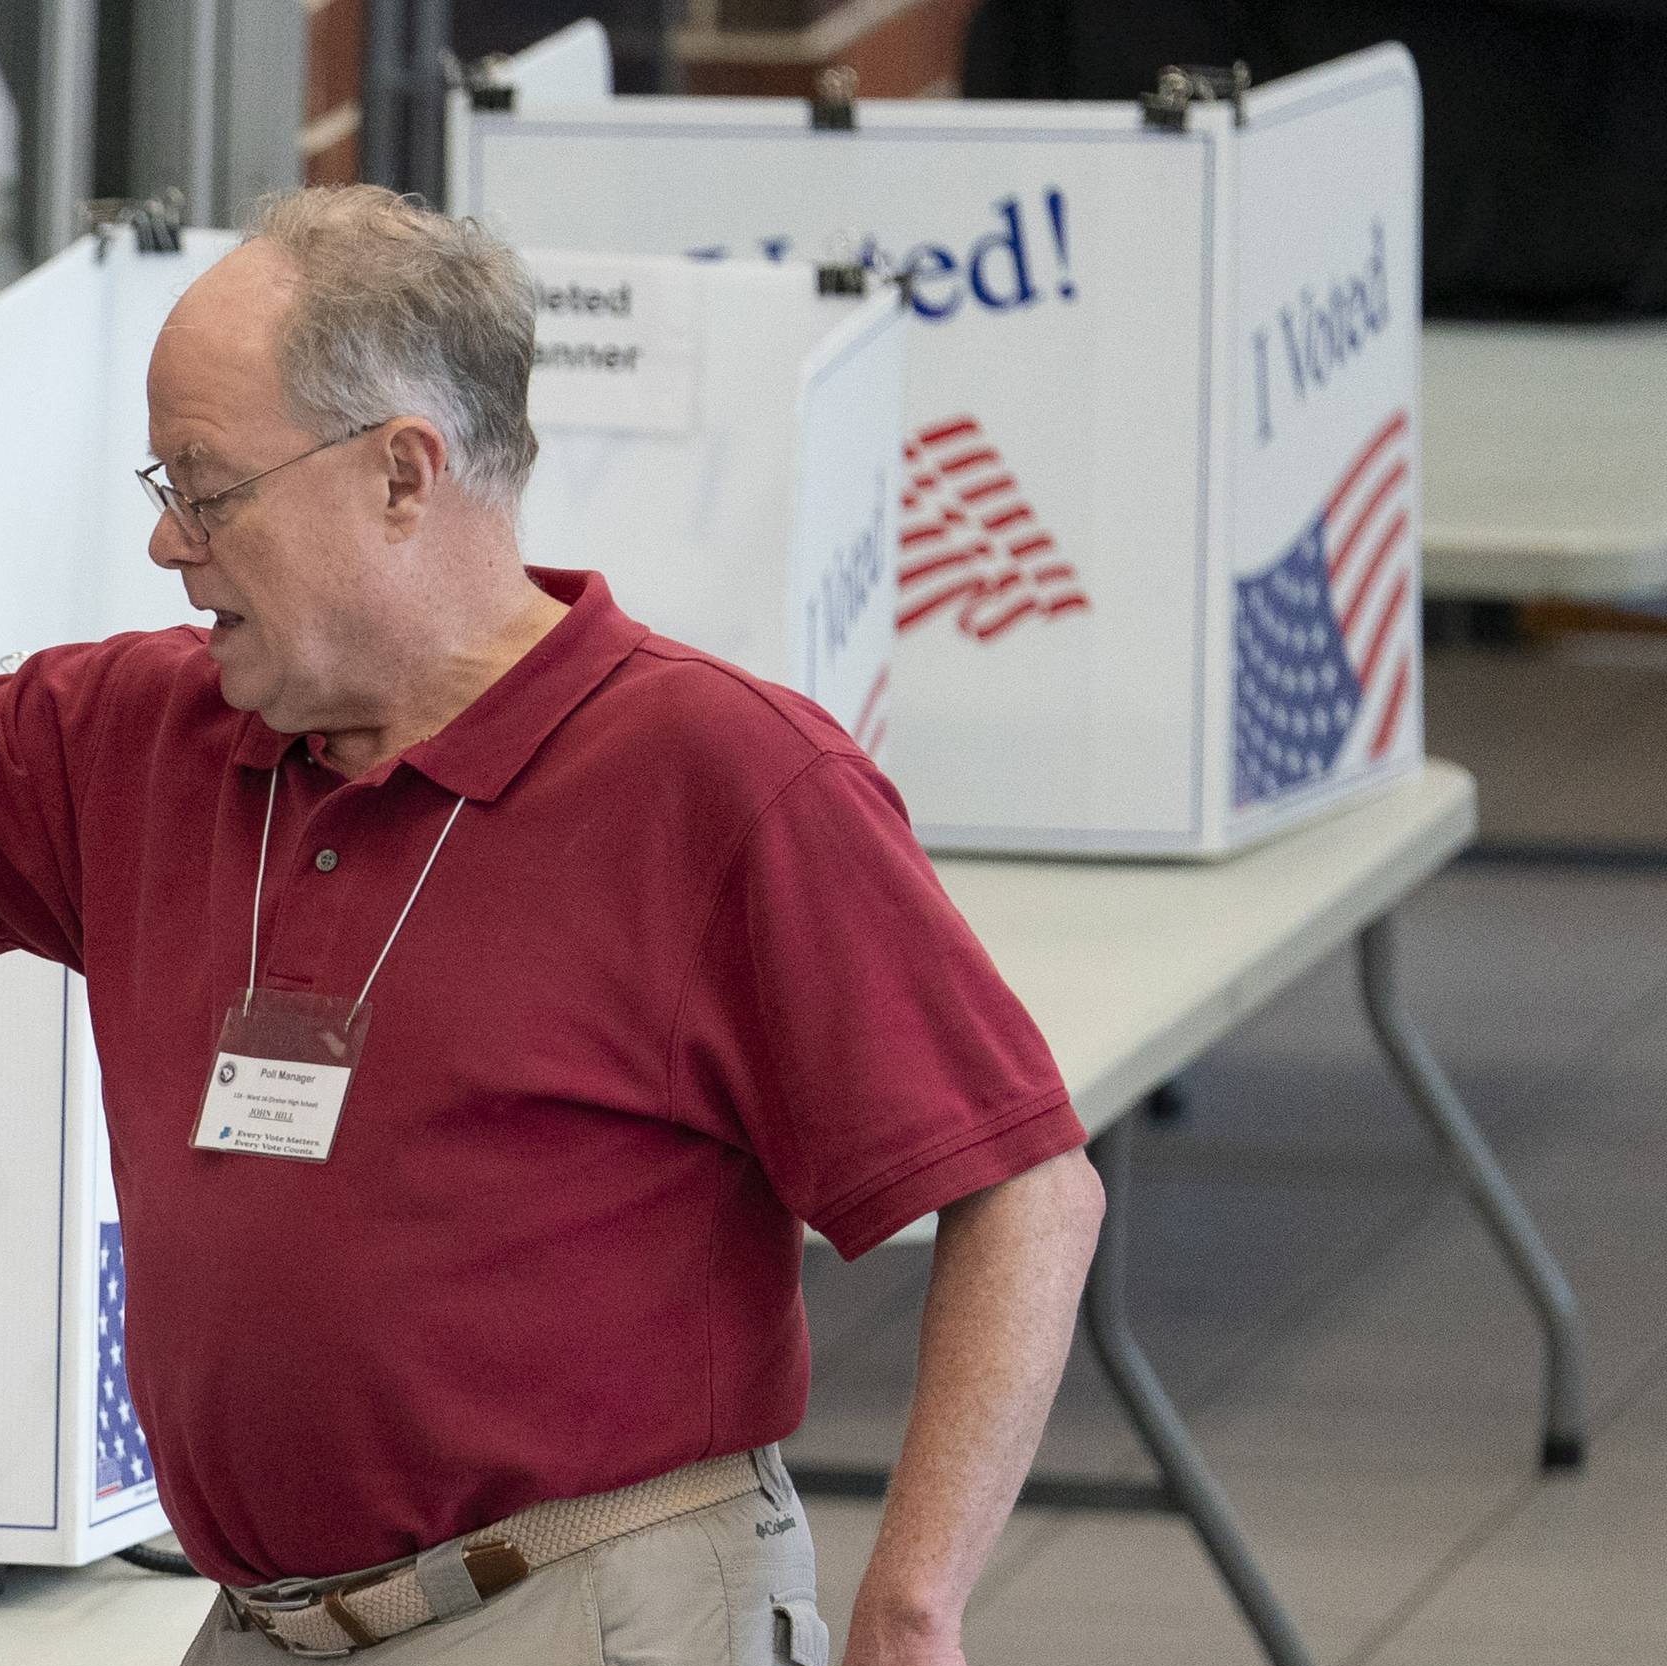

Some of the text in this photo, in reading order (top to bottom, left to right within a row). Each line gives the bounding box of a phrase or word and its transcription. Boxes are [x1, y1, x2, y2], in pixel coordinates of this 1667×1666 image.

[534, 278, 633, 317] leted
[1251, 326, 1274, 442] I
[260, 1068, 316, 1085] Poll Manager
[237, 1130, 262, 1140] Every
[265, 1133, 285, 1142] Vote
[234, 1139, 259, 1149] Every
[262, 1142, 282, 1152] Vote
